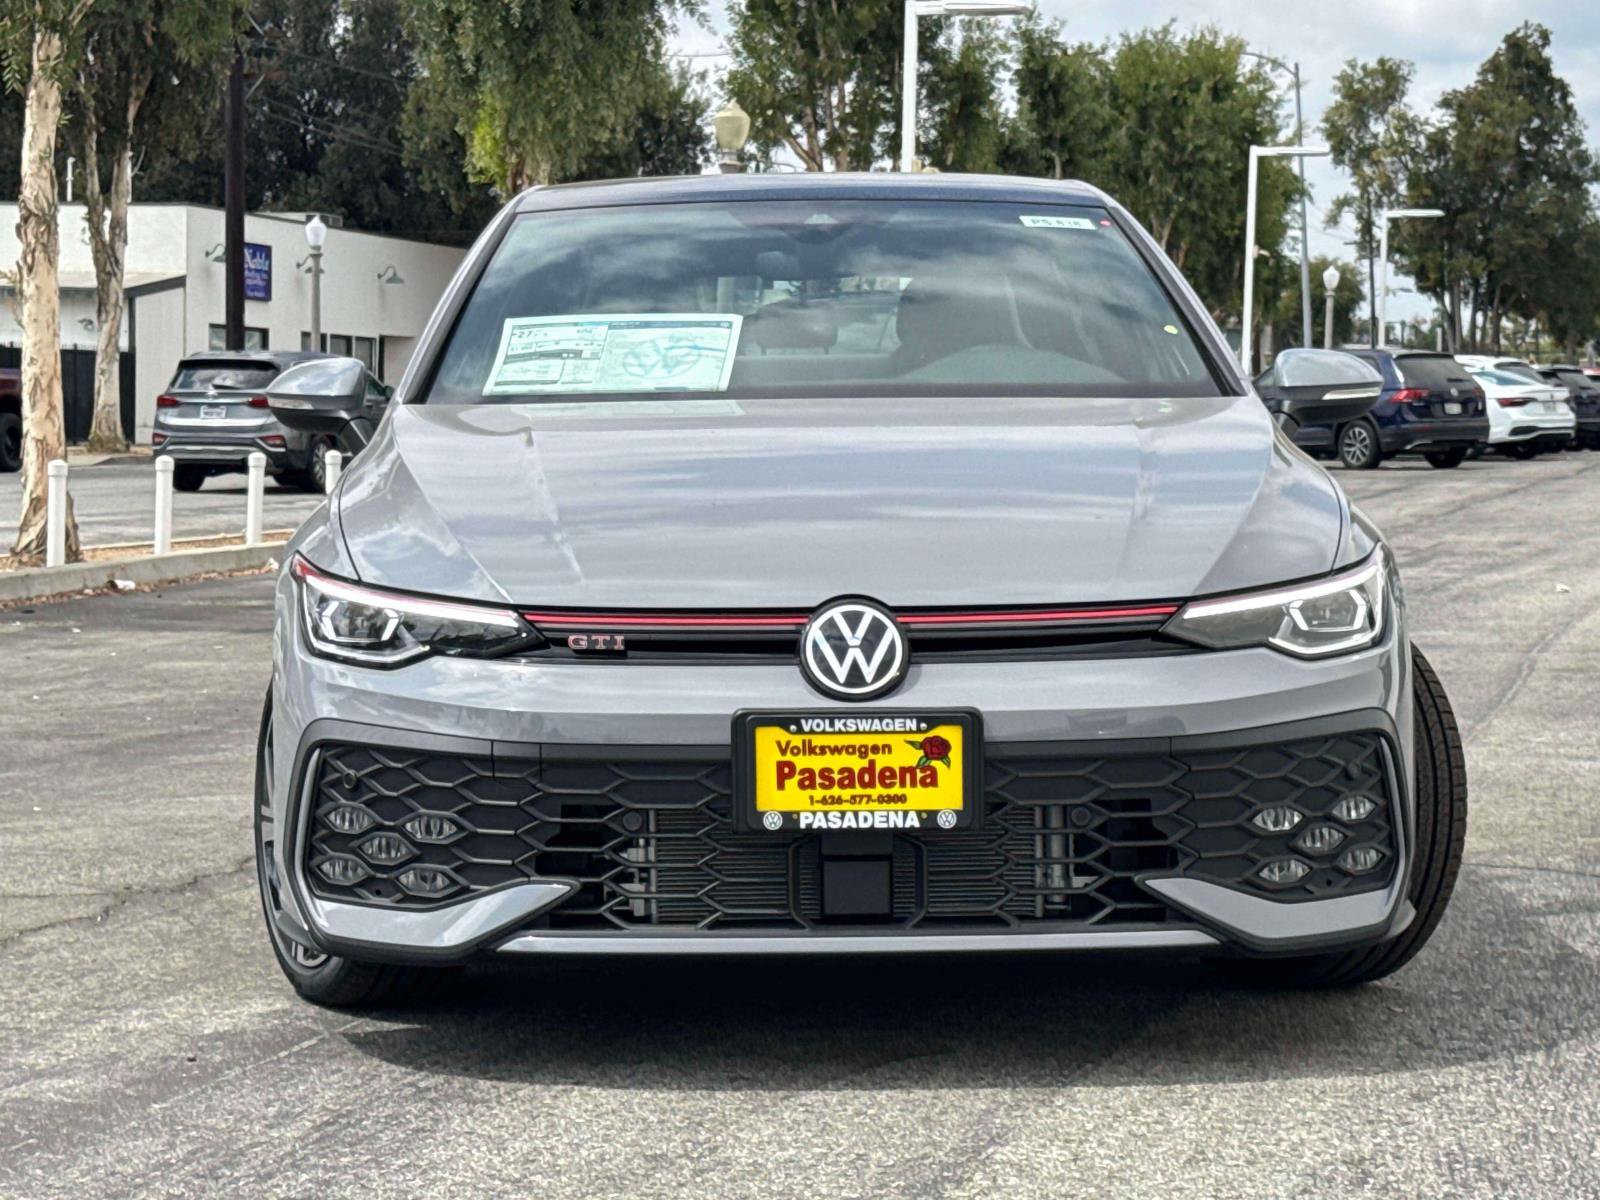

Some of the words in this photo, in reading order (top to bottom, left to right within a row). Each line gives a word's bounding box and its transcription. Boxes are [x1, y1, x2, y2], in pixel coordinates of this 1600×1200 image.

[567, 634, 625, 650] GTI
[800, 718, 917, 733] VOLKSWAGEN
[776, 739, 892, 759] Volkswagen
[776, 759, 939, 791] Pasadena
[799, 811, 920, 829] PASADENA
